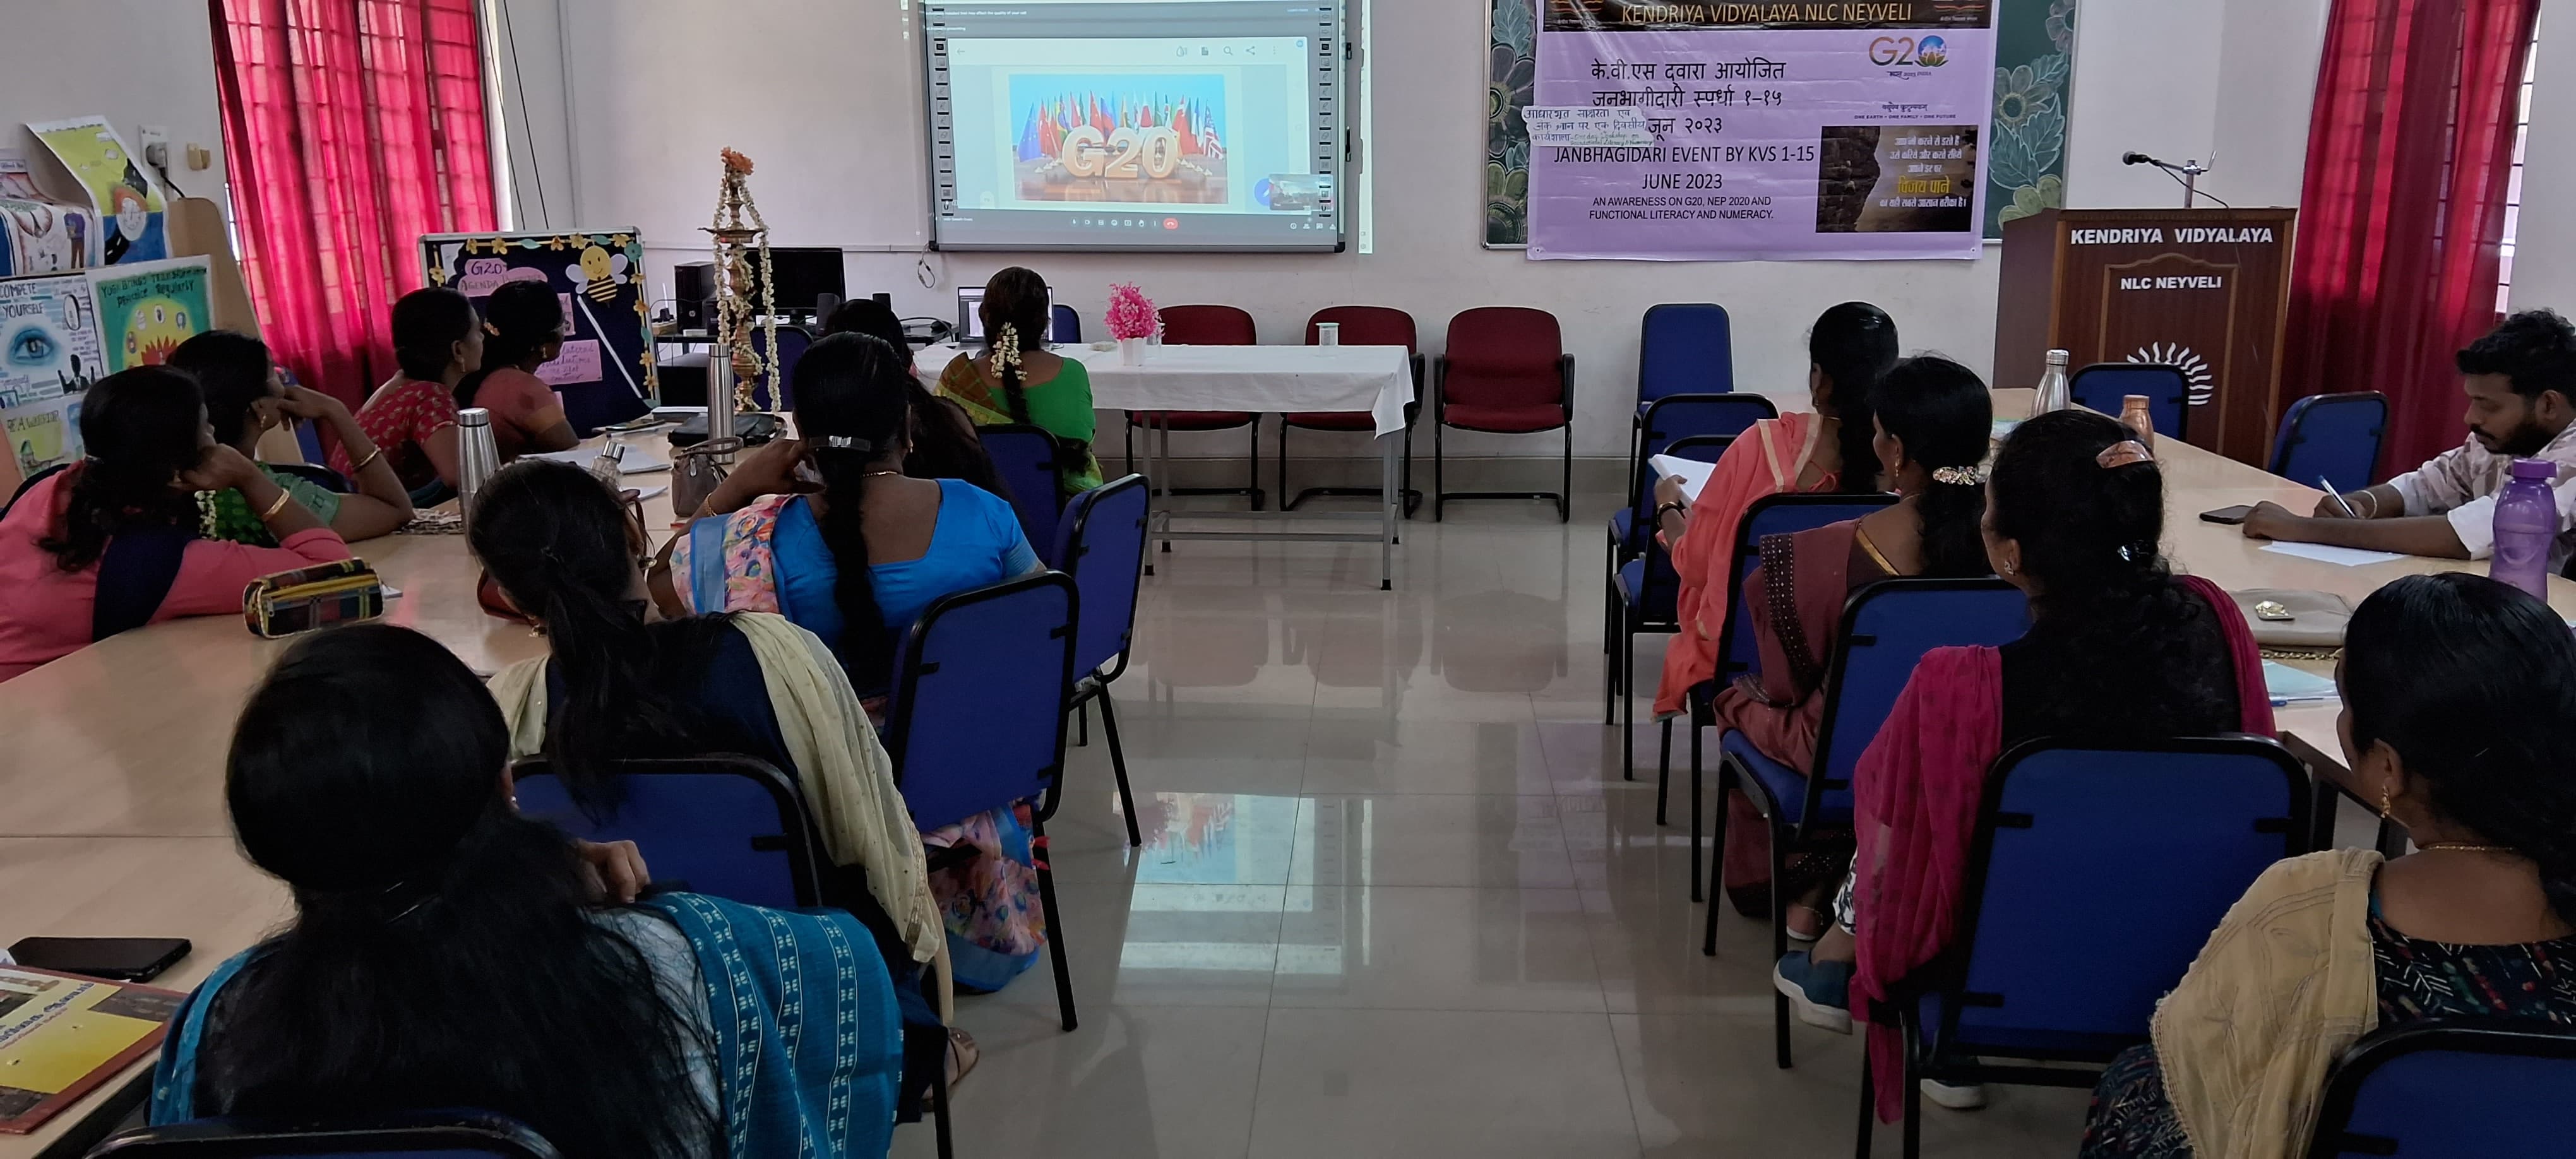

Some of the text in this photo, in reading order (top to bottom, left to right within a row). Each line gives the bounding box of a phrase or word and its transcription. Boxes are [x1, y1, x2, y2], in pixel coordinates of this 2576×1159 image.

[1622, 3, 1912, 23] KENDRIYA VIDYALAYA NLC NEYVELI
[1868, 35, 1949, 68] G20
[1591, 58, 1657, 80] के.वी.एस
[1714, 57, 1786, 80] आयोजित
[1592, 83, 1686, 108] जनभागीदारी
[1693, 85, 1735, 107] स्पर्धा
[1647, 118, 1723, 142] जून २०२३
[1062, 126, 1179, 179] G20
[1554, 145, 1815, 163] JANBHAGIDARI EVENT BY KVS 1-15
[1642, 173, 1723, 190] JUNE 2023
[1898, 175, 1928, 193] विजय
[1593, 196, 1772, 208] AN AWARENESS ON G20, NEP 2020 AND
[1589, 210, 1774, 220] FUNCTIONAL LITERACY AND NUMERACY.
[2070, 227, 2274, 245] KENDRIYA VIDYALAYA
[2120, 275, 2222, 290] NLC NEYVELI
[3, 302, 44, 319] YOURSELF
